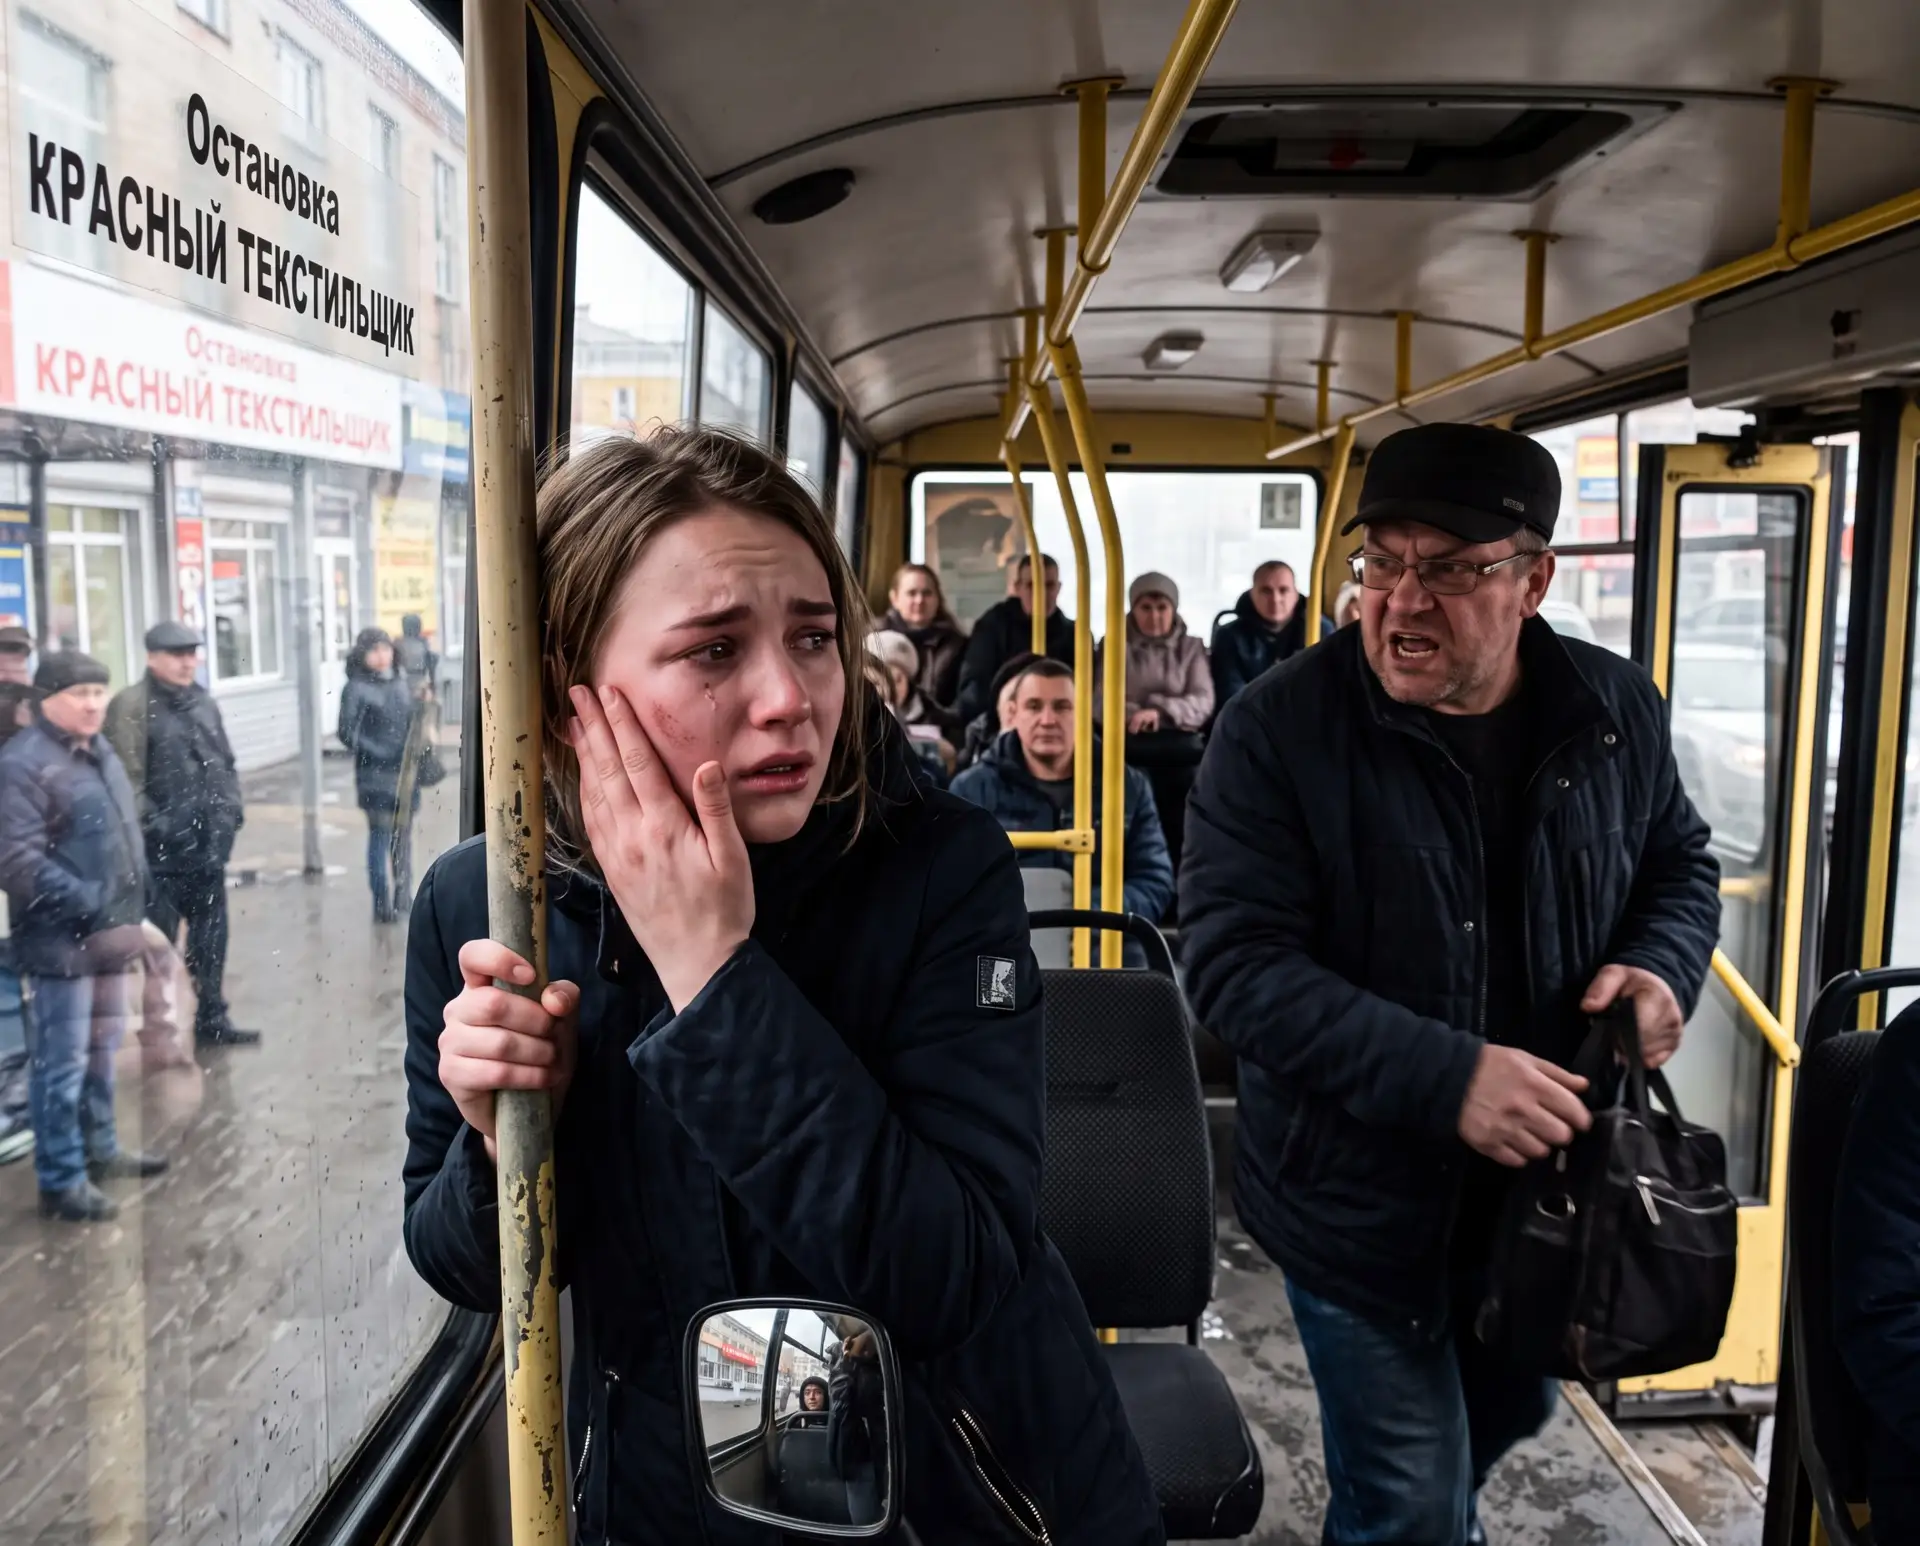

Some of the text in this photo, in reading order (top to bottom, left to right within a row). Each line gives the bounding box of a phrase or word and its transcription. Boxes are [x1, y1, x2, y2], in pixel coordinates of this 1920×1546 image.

[187, 92, 341, 237] Остановка
[28, 131, 415, 358] КРАСНЫЙ ТЕКСТИЛЬЩИК
[35, 342, 392, 454] КРАСНЫЙ ТЕКСТИЛЬЩИК
[185, 325, 298, 384] Остановка
